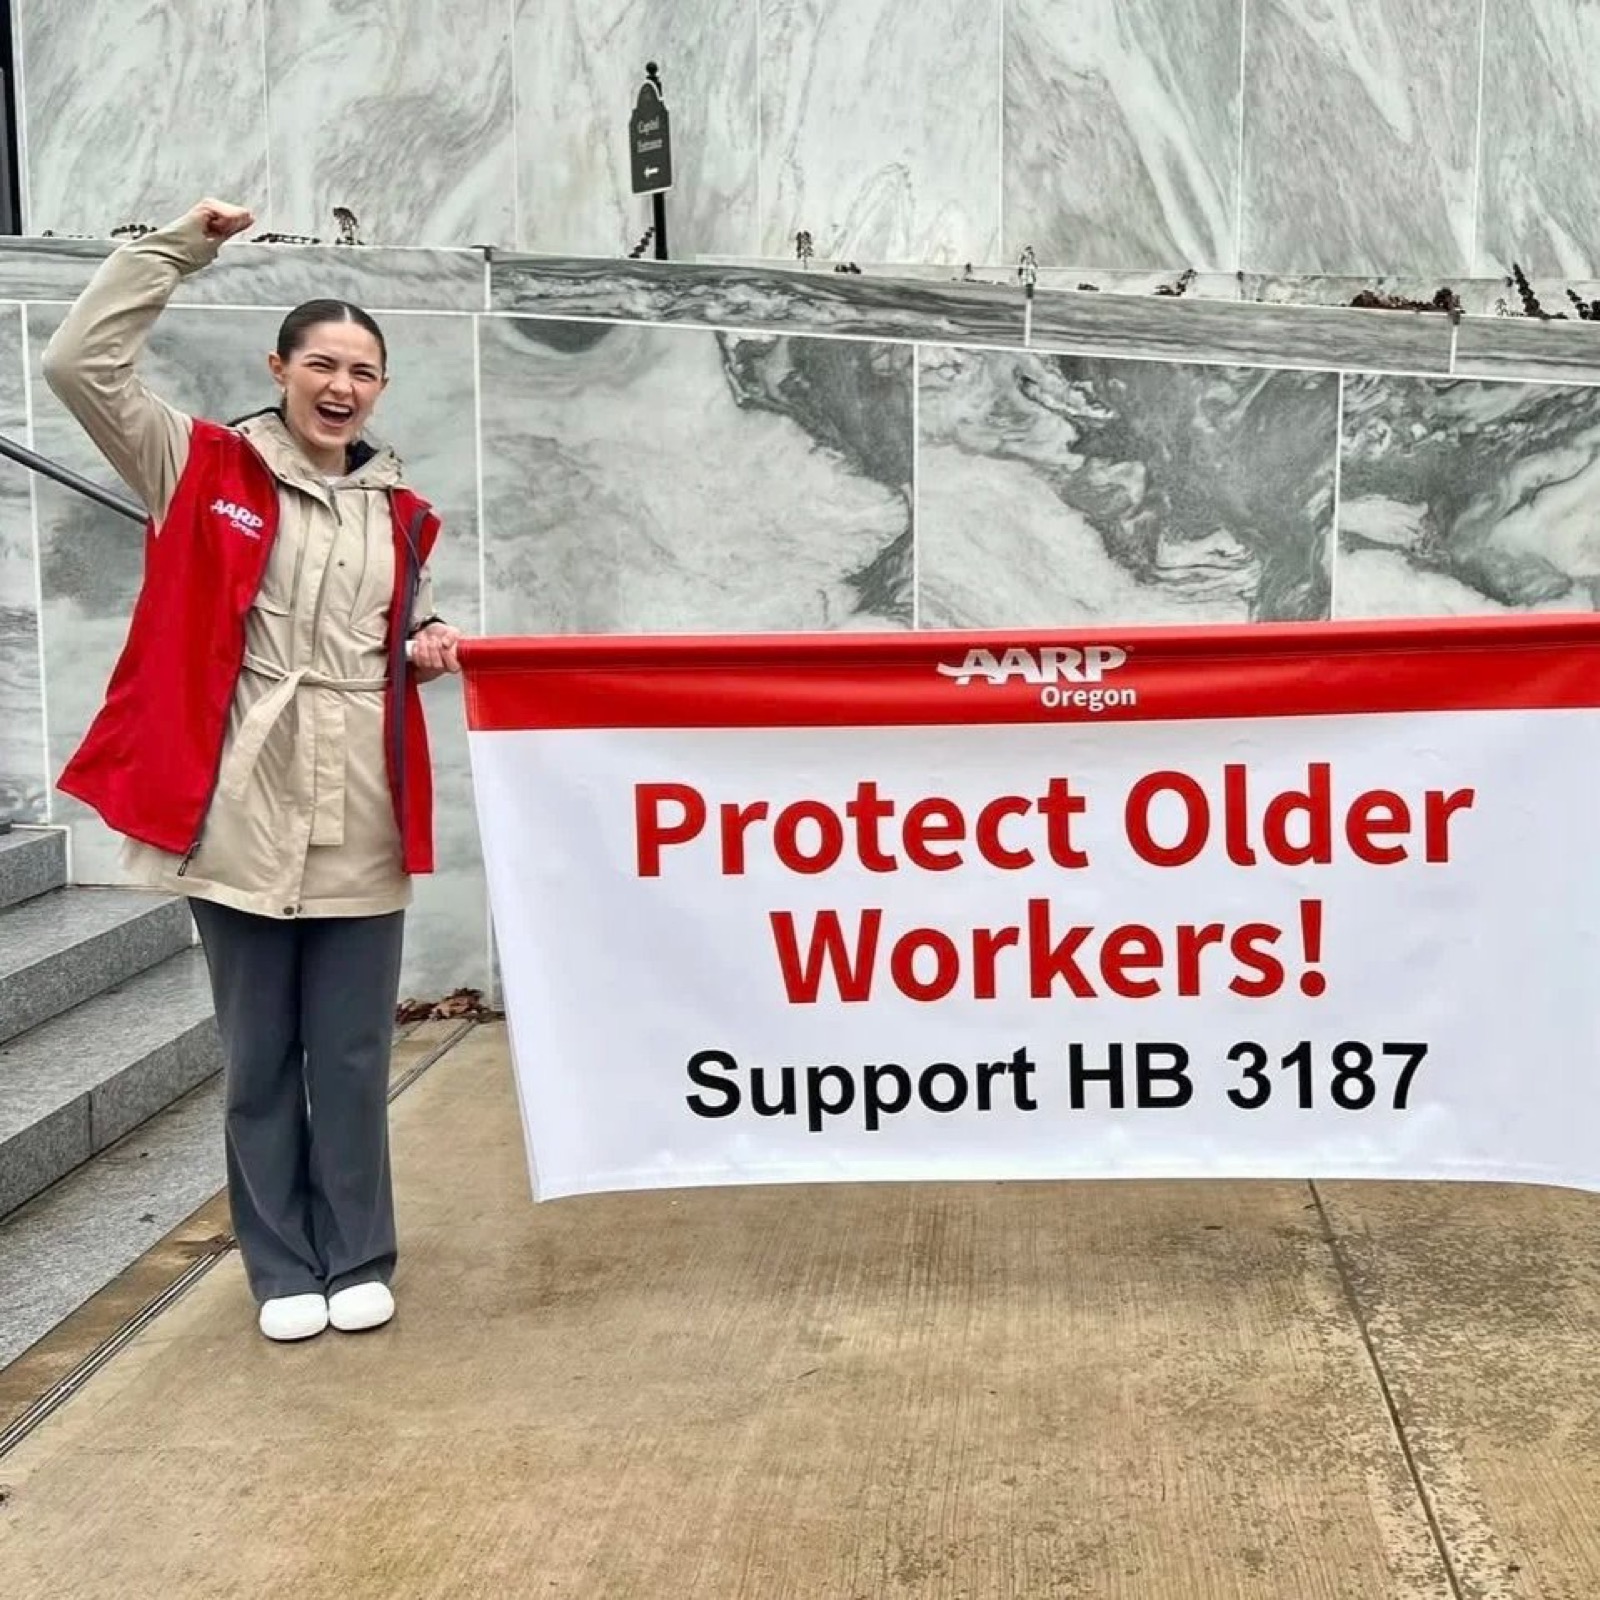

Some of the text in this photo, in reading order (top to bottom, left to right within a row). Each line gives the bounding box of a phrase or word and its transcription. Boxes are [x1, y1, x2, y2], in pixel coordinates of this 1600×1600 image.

[209, 499, 264, 528] AARP
[936, 645, 1128, 685] AARP
[1040, 685, 1137, 712] Oregon
[635, 763, 1474, 877] Protect Older
[770, 899, 1326, 1004] Workers!
[686, 1041, 1427, 1132] Support HB 3187
